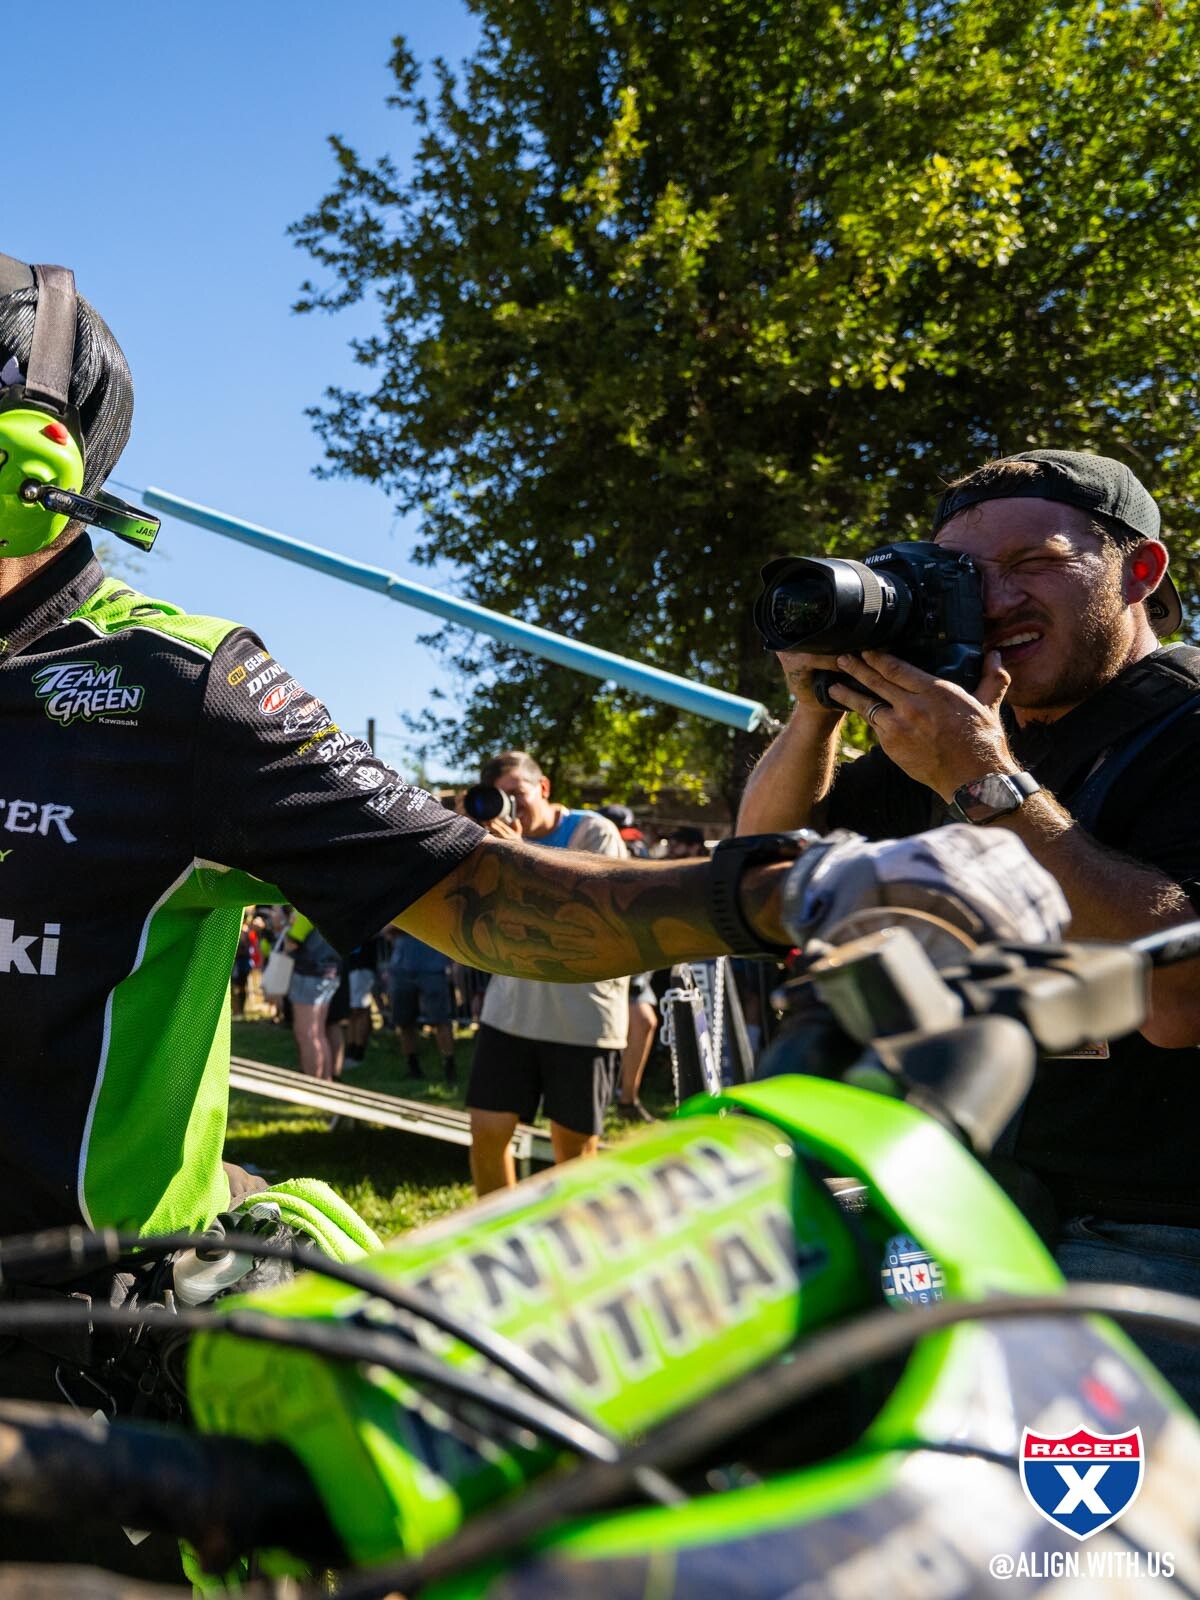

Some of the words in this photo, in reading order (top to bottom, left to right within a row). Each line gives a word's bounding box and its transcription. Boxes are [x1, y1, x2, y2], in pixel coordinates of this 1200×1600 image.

[865, 552, 893, 565] Nikon
[35, 663, 118, 694] TEAM
[47, 688, 141, 722] GREEN
[98, 716, 138, 726] Kawasaki
